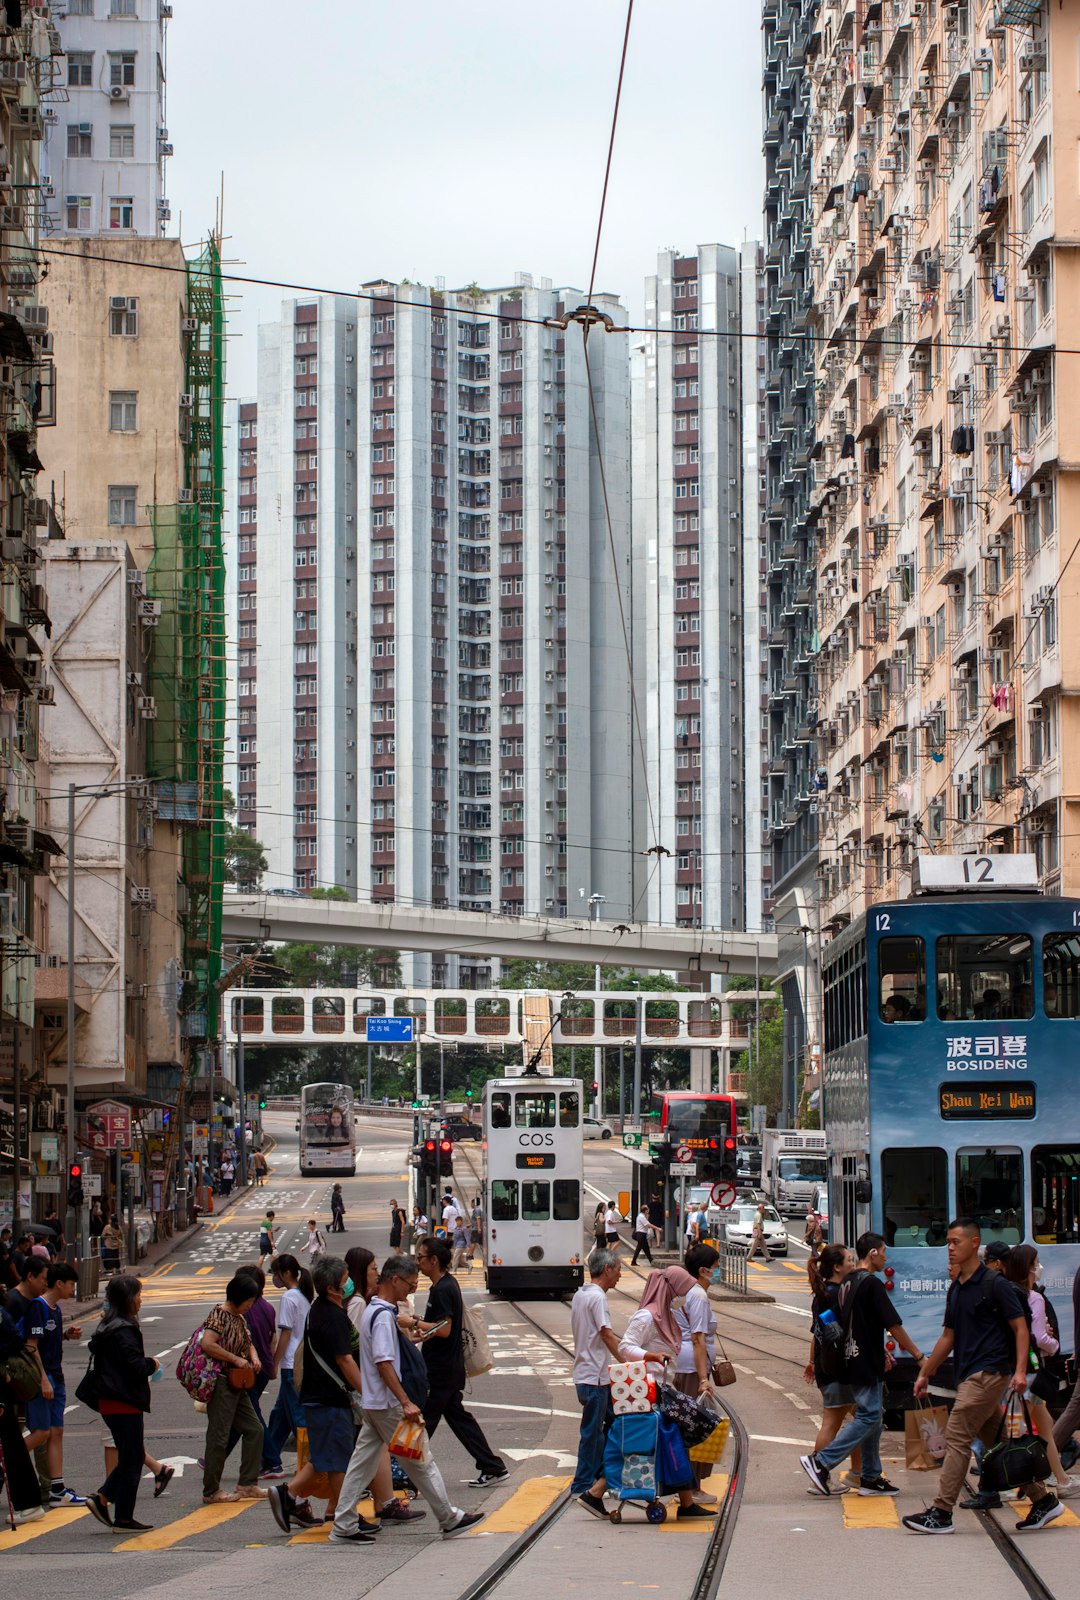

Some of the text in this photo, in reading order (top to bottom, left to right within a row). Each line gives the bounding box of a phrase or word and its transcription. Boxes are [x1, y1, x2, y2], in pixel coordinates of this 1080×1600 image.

[962, 857, 994, 883] 12
[875, 913, 891, 931] 12
[946, 1035, 1027, 1058] 波司登
[946, 1059, 1028, 1072] BOSIDENG
[941, 1092, 1033, 1110] Shau Kei Wan
[518, 1133, 554, 1147] COS
[572, 1269, 579, 1277] 21
